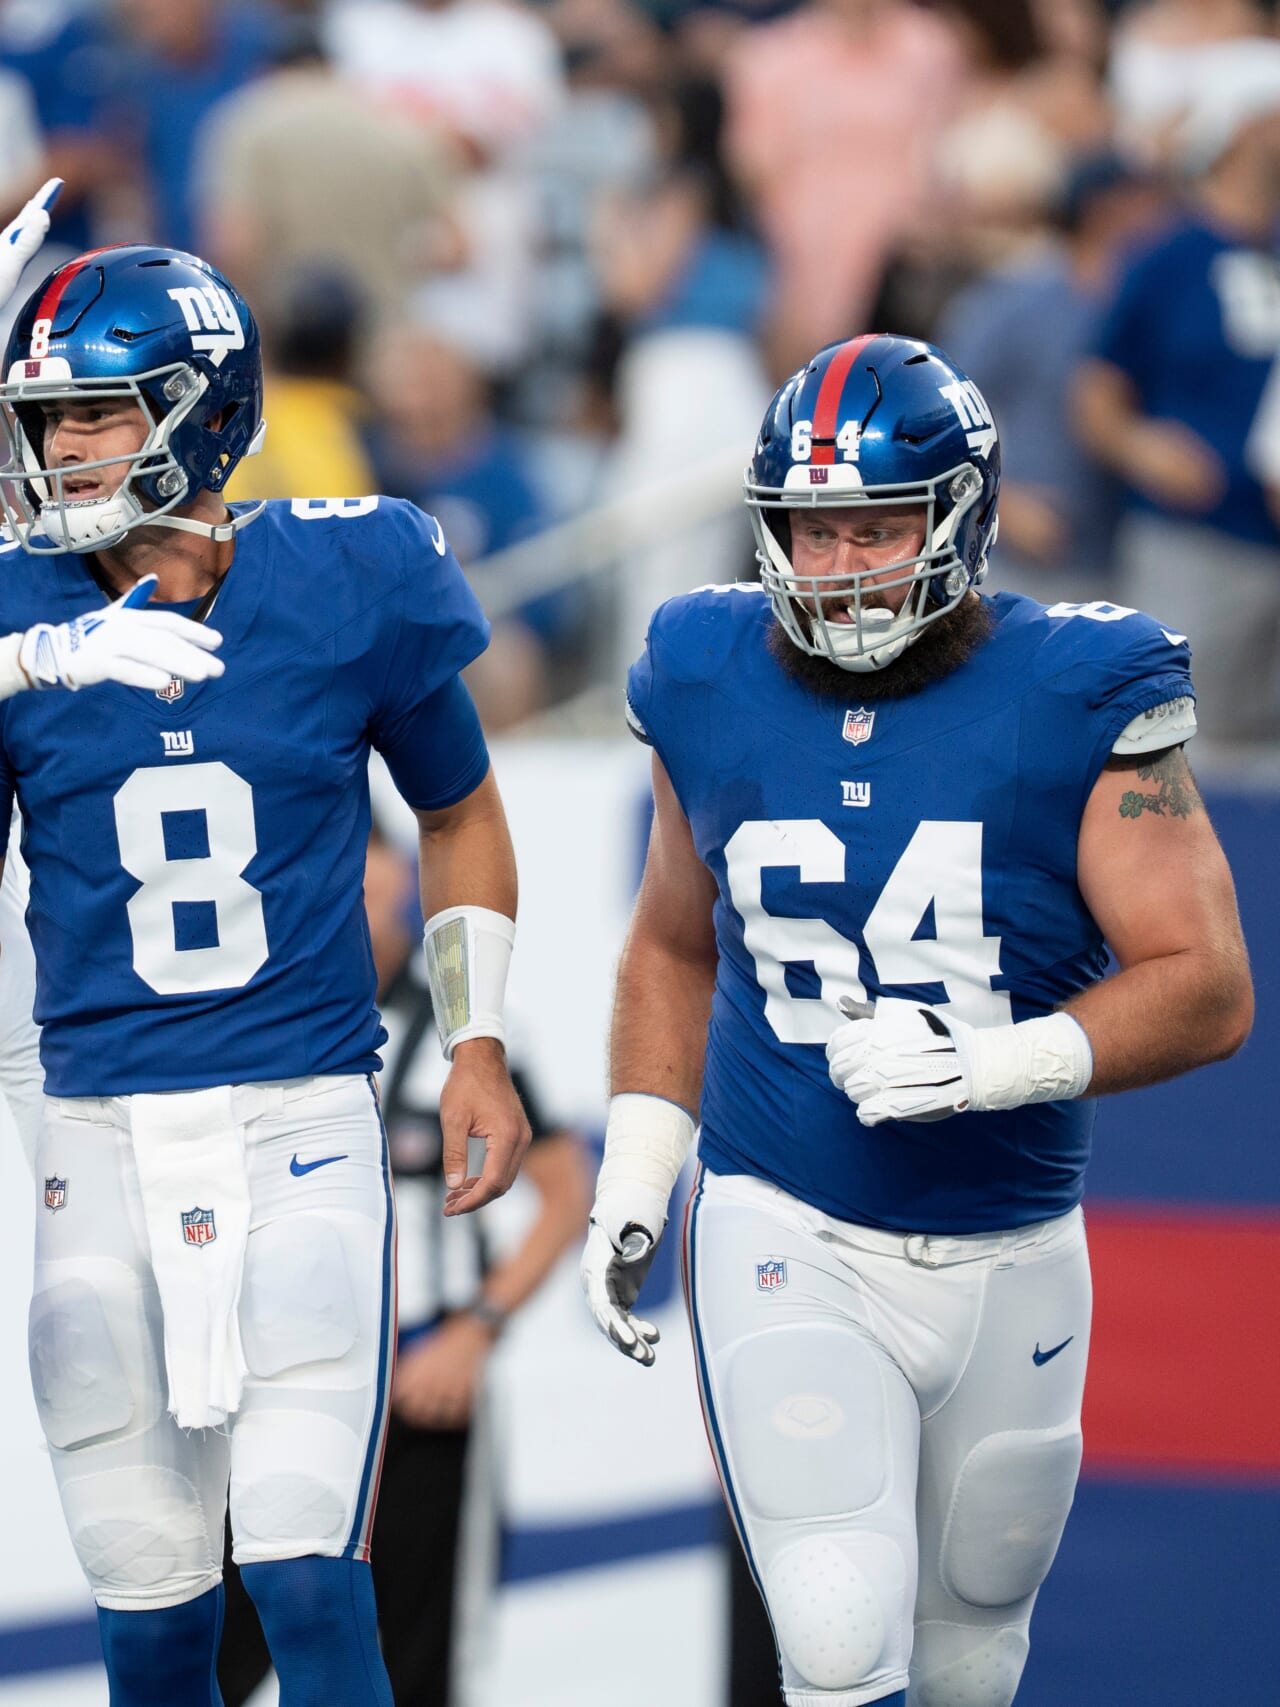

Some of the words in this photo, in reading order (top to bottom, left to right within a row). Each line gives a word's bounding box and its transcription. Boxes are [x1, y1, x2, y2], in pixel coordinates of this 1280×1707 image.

[30, 318, 53, 359] 8
[847, 720, 870, 738] NFL
[159, 730, 195, 756] ny
[840, 780, 871, 807] ny
[113, 760, 270, 996] 8
[723, 818, 1015, 1044] 64
[46, 1189, 63, 1206] NFL
[185, 1223, 214, 1243] NFL
[760, 1270, 782, 1287] NFL
